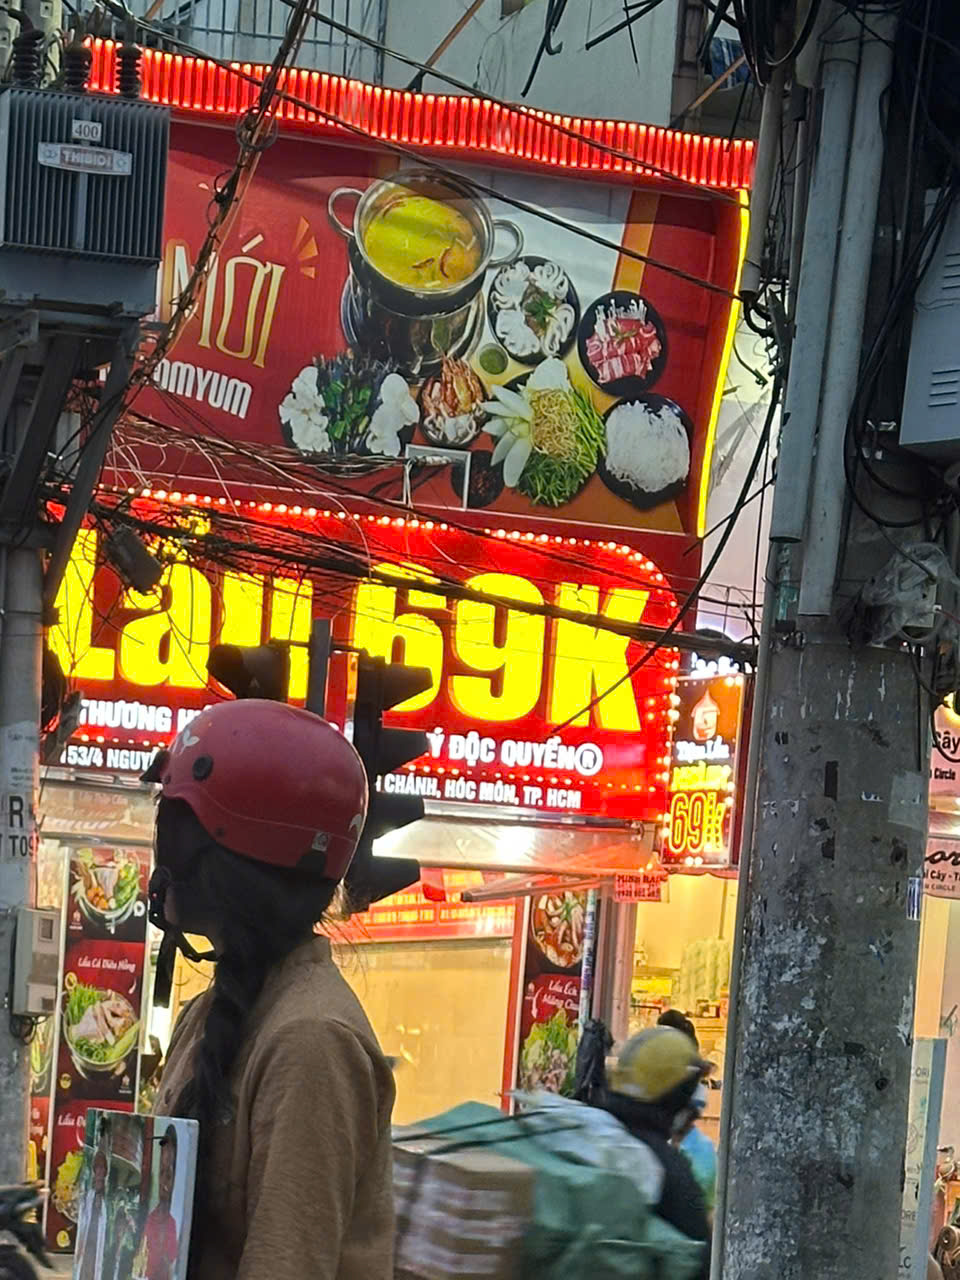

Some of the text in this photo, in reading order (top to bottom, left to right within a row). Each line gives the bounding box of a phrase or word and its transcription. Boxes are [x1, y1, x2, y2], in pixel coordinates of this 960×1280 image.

[75, 124, 99, 139] 400
[352, 561, 650, 732] 69K
[449, 731, 497, 767] ĐỘC
[445, 775, 478, 800] HÓC
[546, 789, 582, 809] HCM
